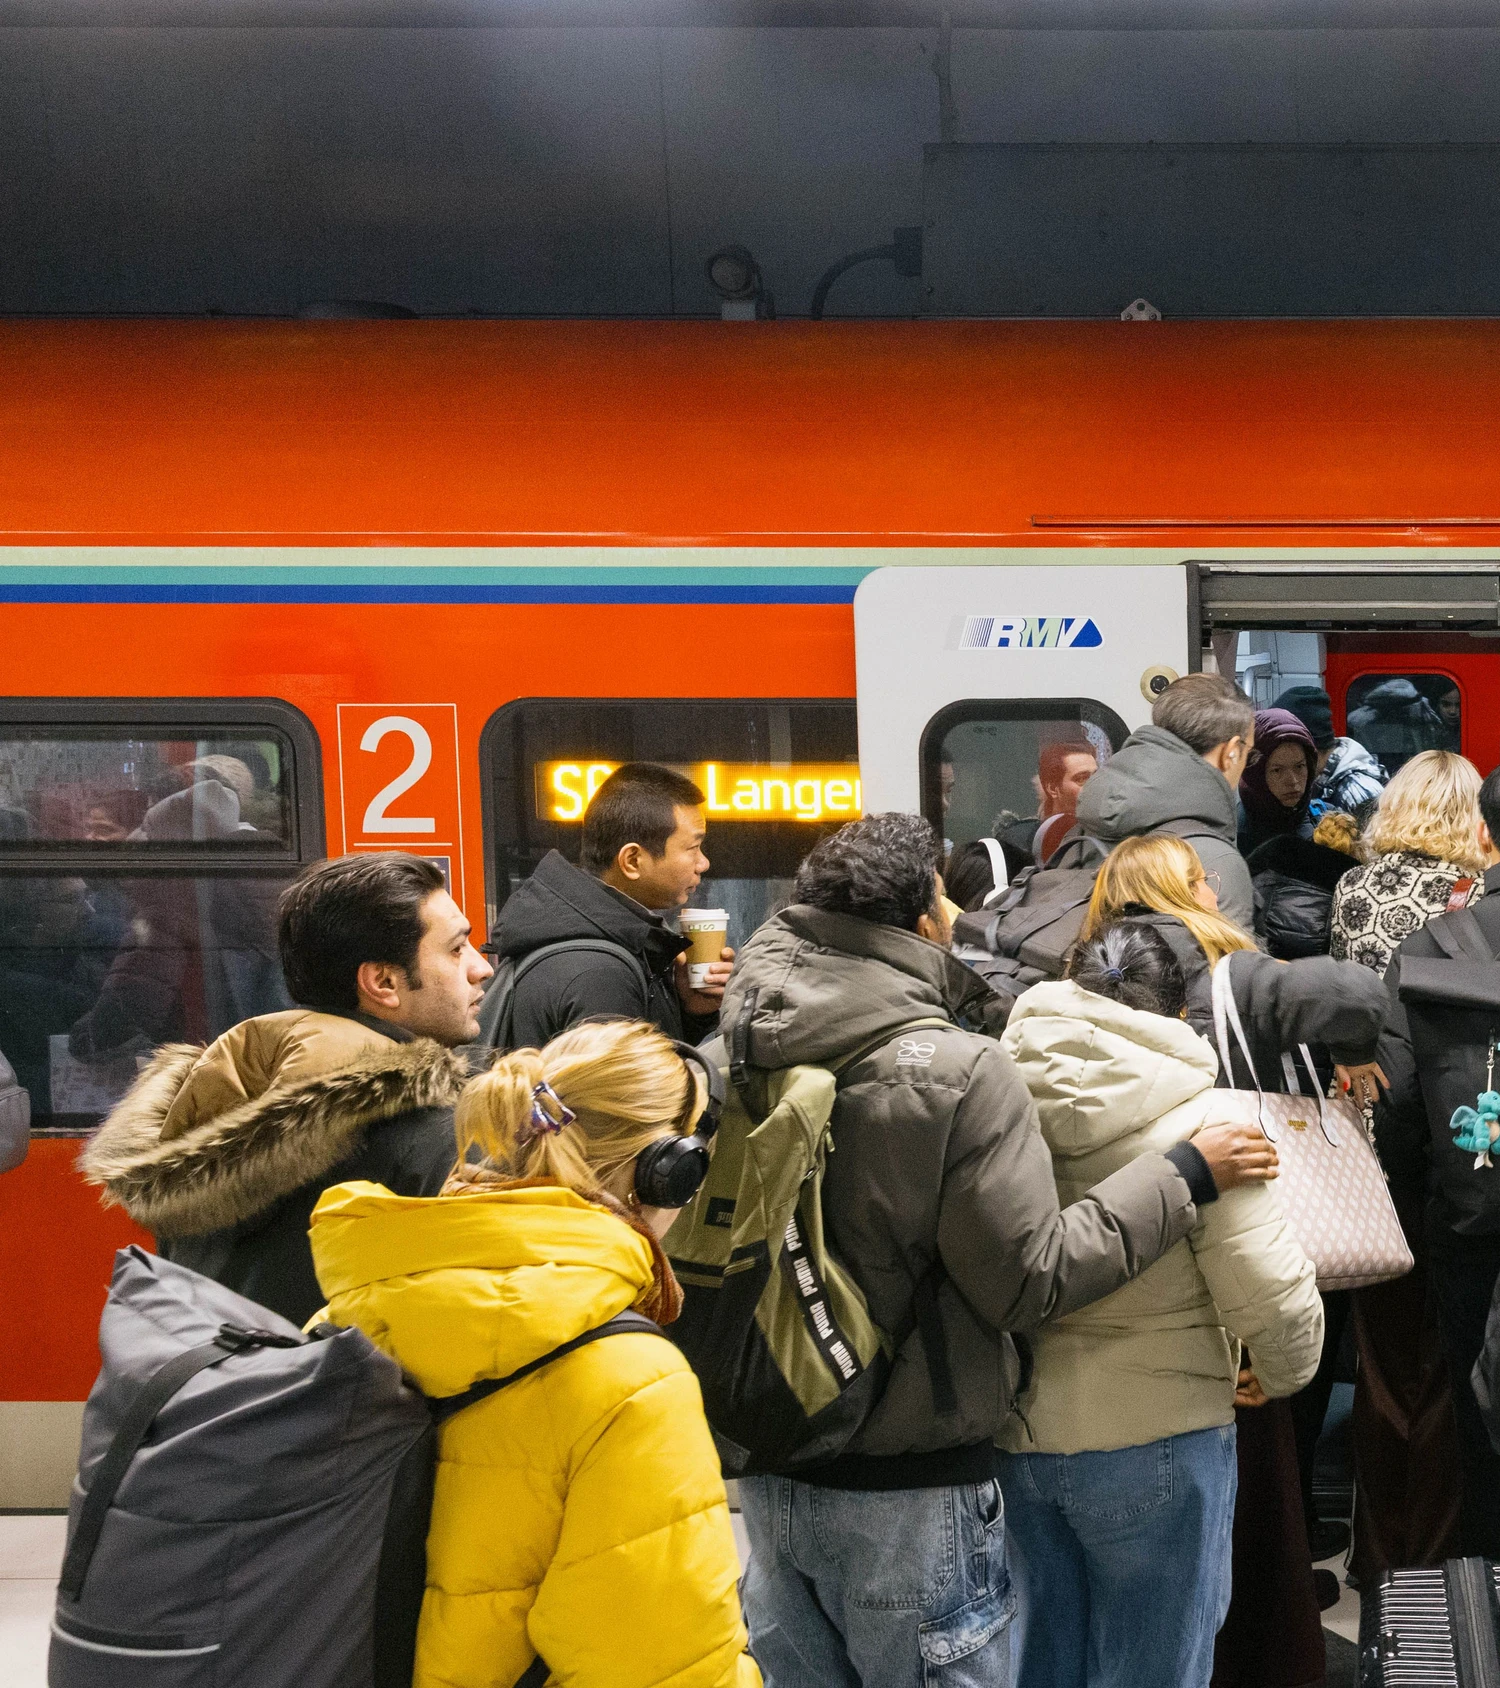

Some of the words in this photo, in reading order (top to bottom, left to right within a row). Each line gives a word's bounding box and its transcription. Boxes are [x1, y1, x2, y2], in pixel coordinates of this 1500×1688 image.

[987, 617, 1090, 648] RMV
[360, 715, 435, 833] 2
[785, 1215, 802, 1251] PUM
[793, 1256, 818, 1297] PUMA
[809, 1300, 834, 1340] PUMA
[829, 1341, 856, 1379] PUMA
